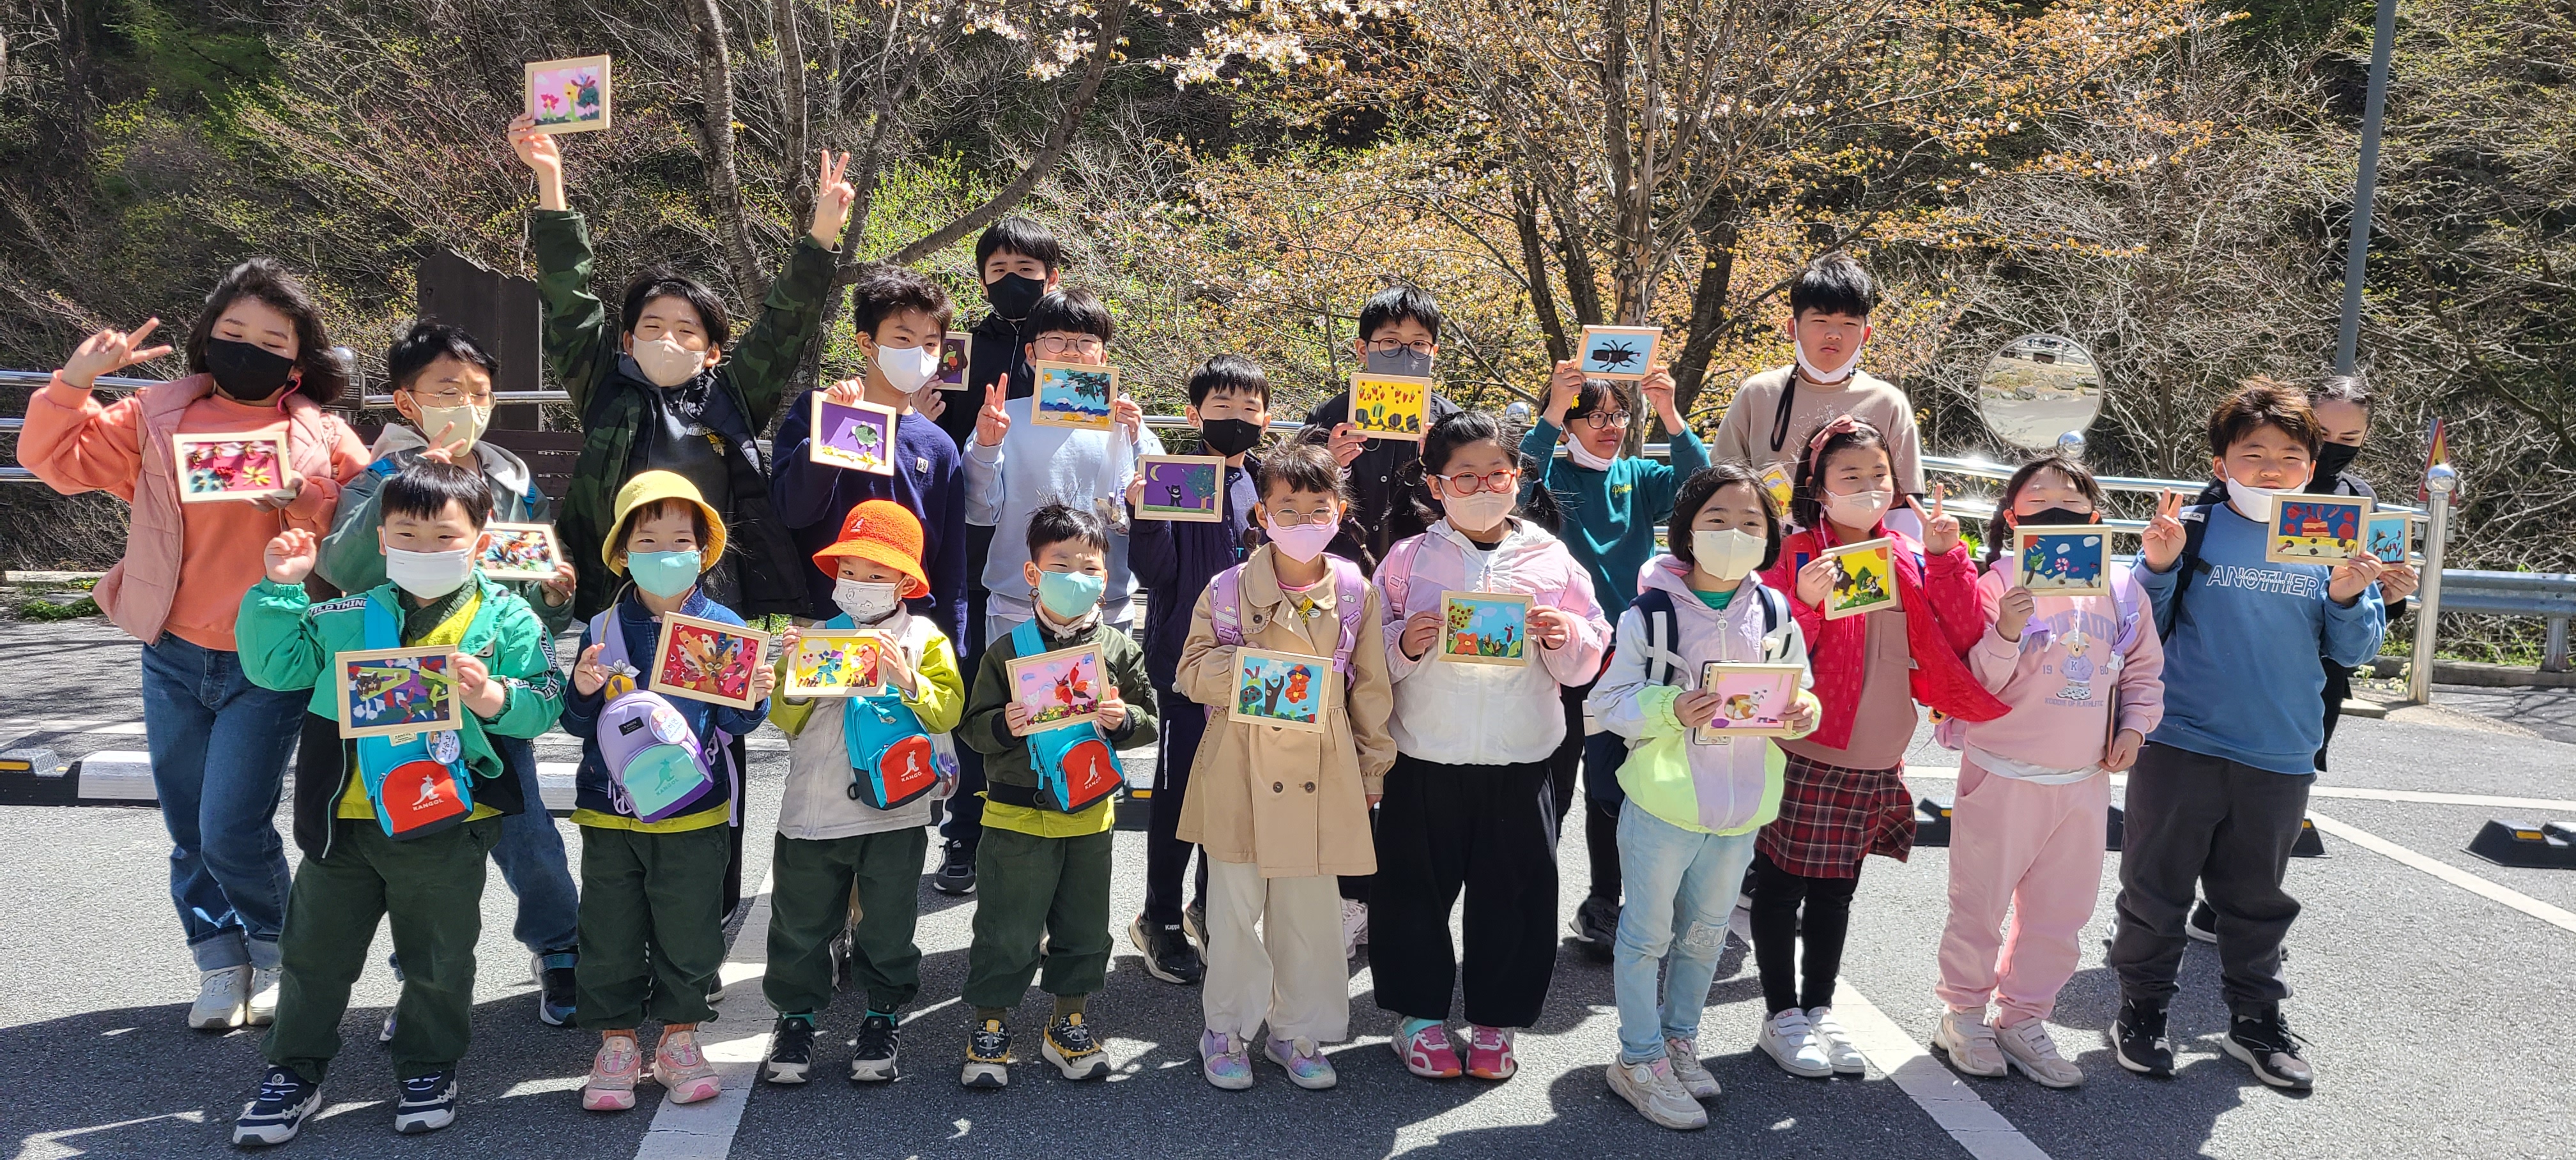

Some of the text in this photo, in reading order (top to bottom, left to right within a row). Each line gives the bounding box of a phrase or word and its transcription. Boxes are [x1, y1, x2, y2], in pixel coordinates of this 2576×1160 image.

[2206, 565, 2319, 600] ANOTHER
[2043, 665, 2052, 674] 19
[2071, 660, 2077, 671] K
[901, 771, 923, 782] KANGO
[656, 778, 679, 796] KANGOL
[412, 798, 445, 811] KANGOL
